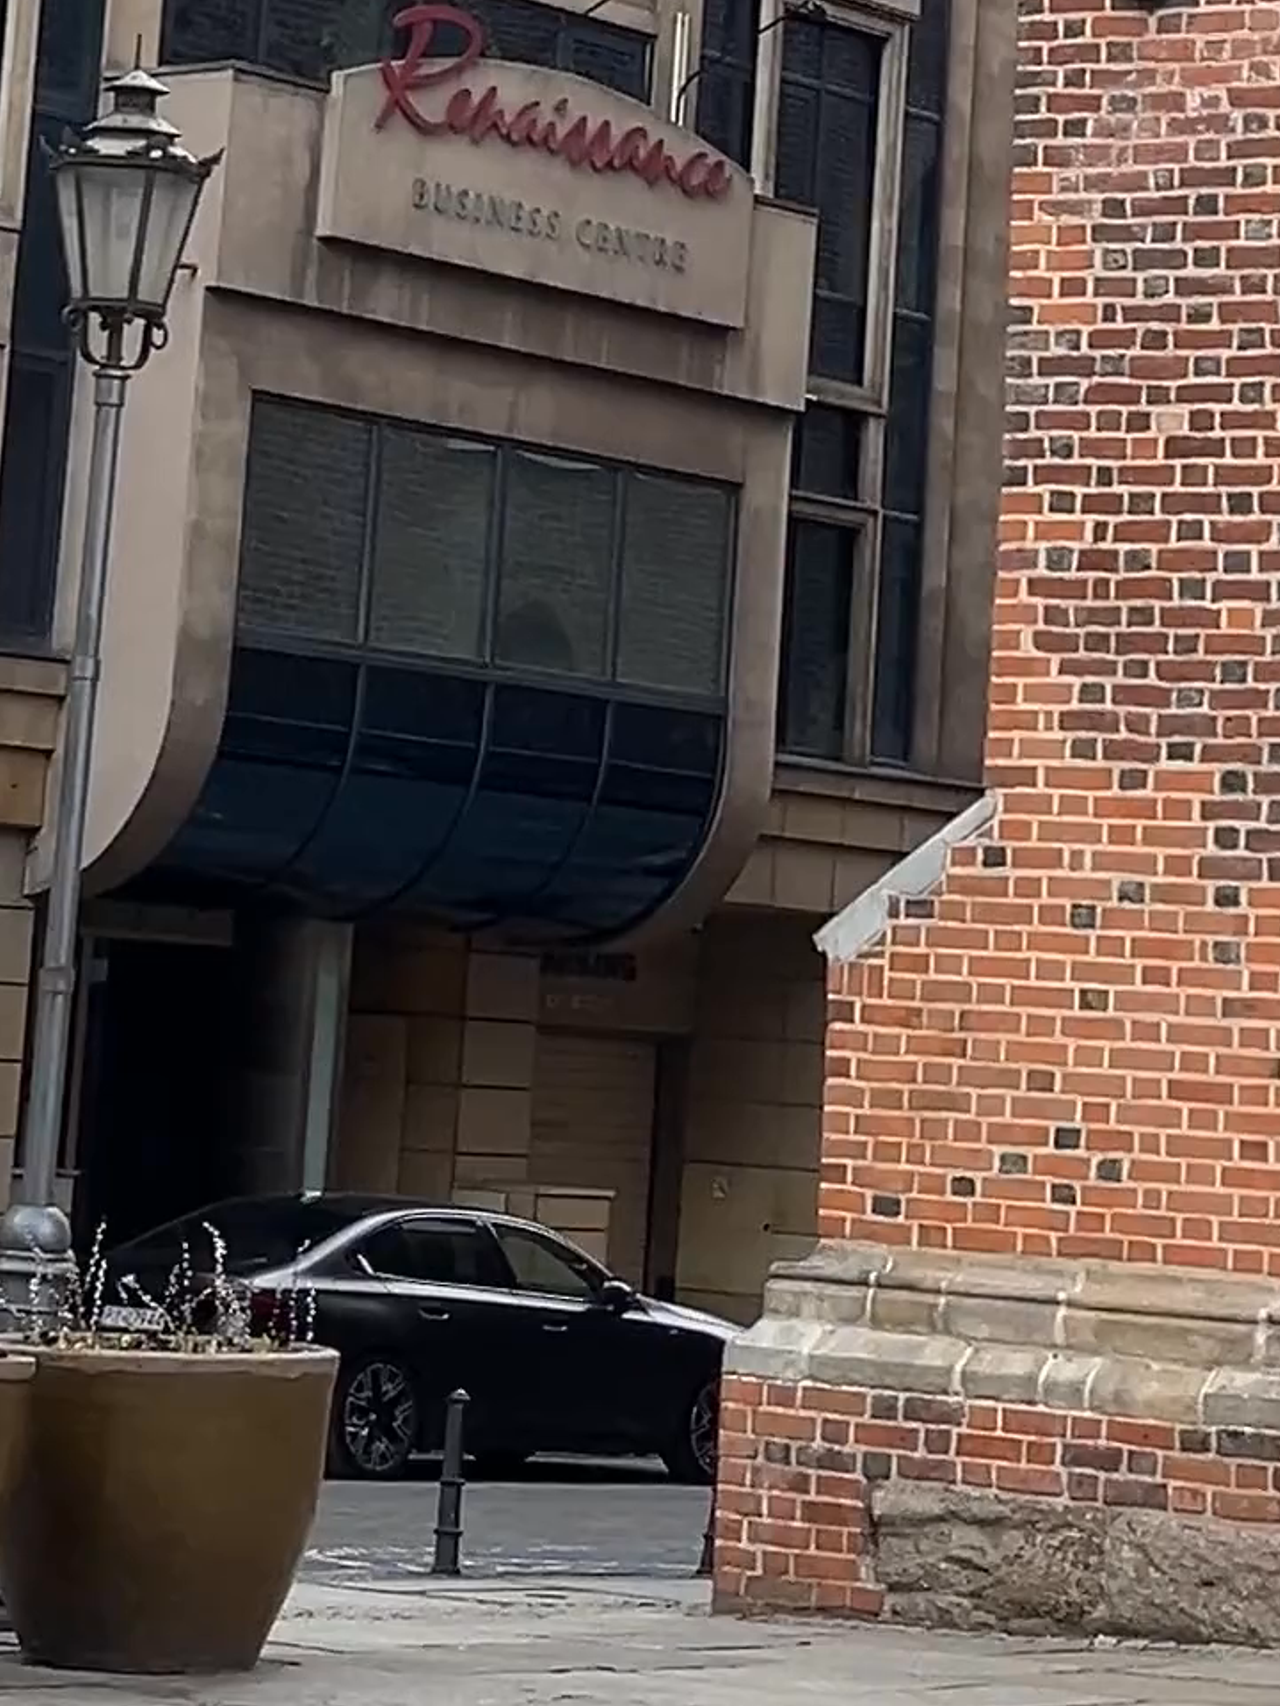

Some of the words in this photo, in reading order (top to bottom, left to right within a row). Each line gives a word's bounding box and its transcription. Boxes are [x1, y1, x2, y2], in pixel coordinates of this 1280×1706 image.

[374, 4, 732, 199] Renaissance
[412, 178, 560, 238] BUSINESS
[575, 219, 688, 272] CENTRE
